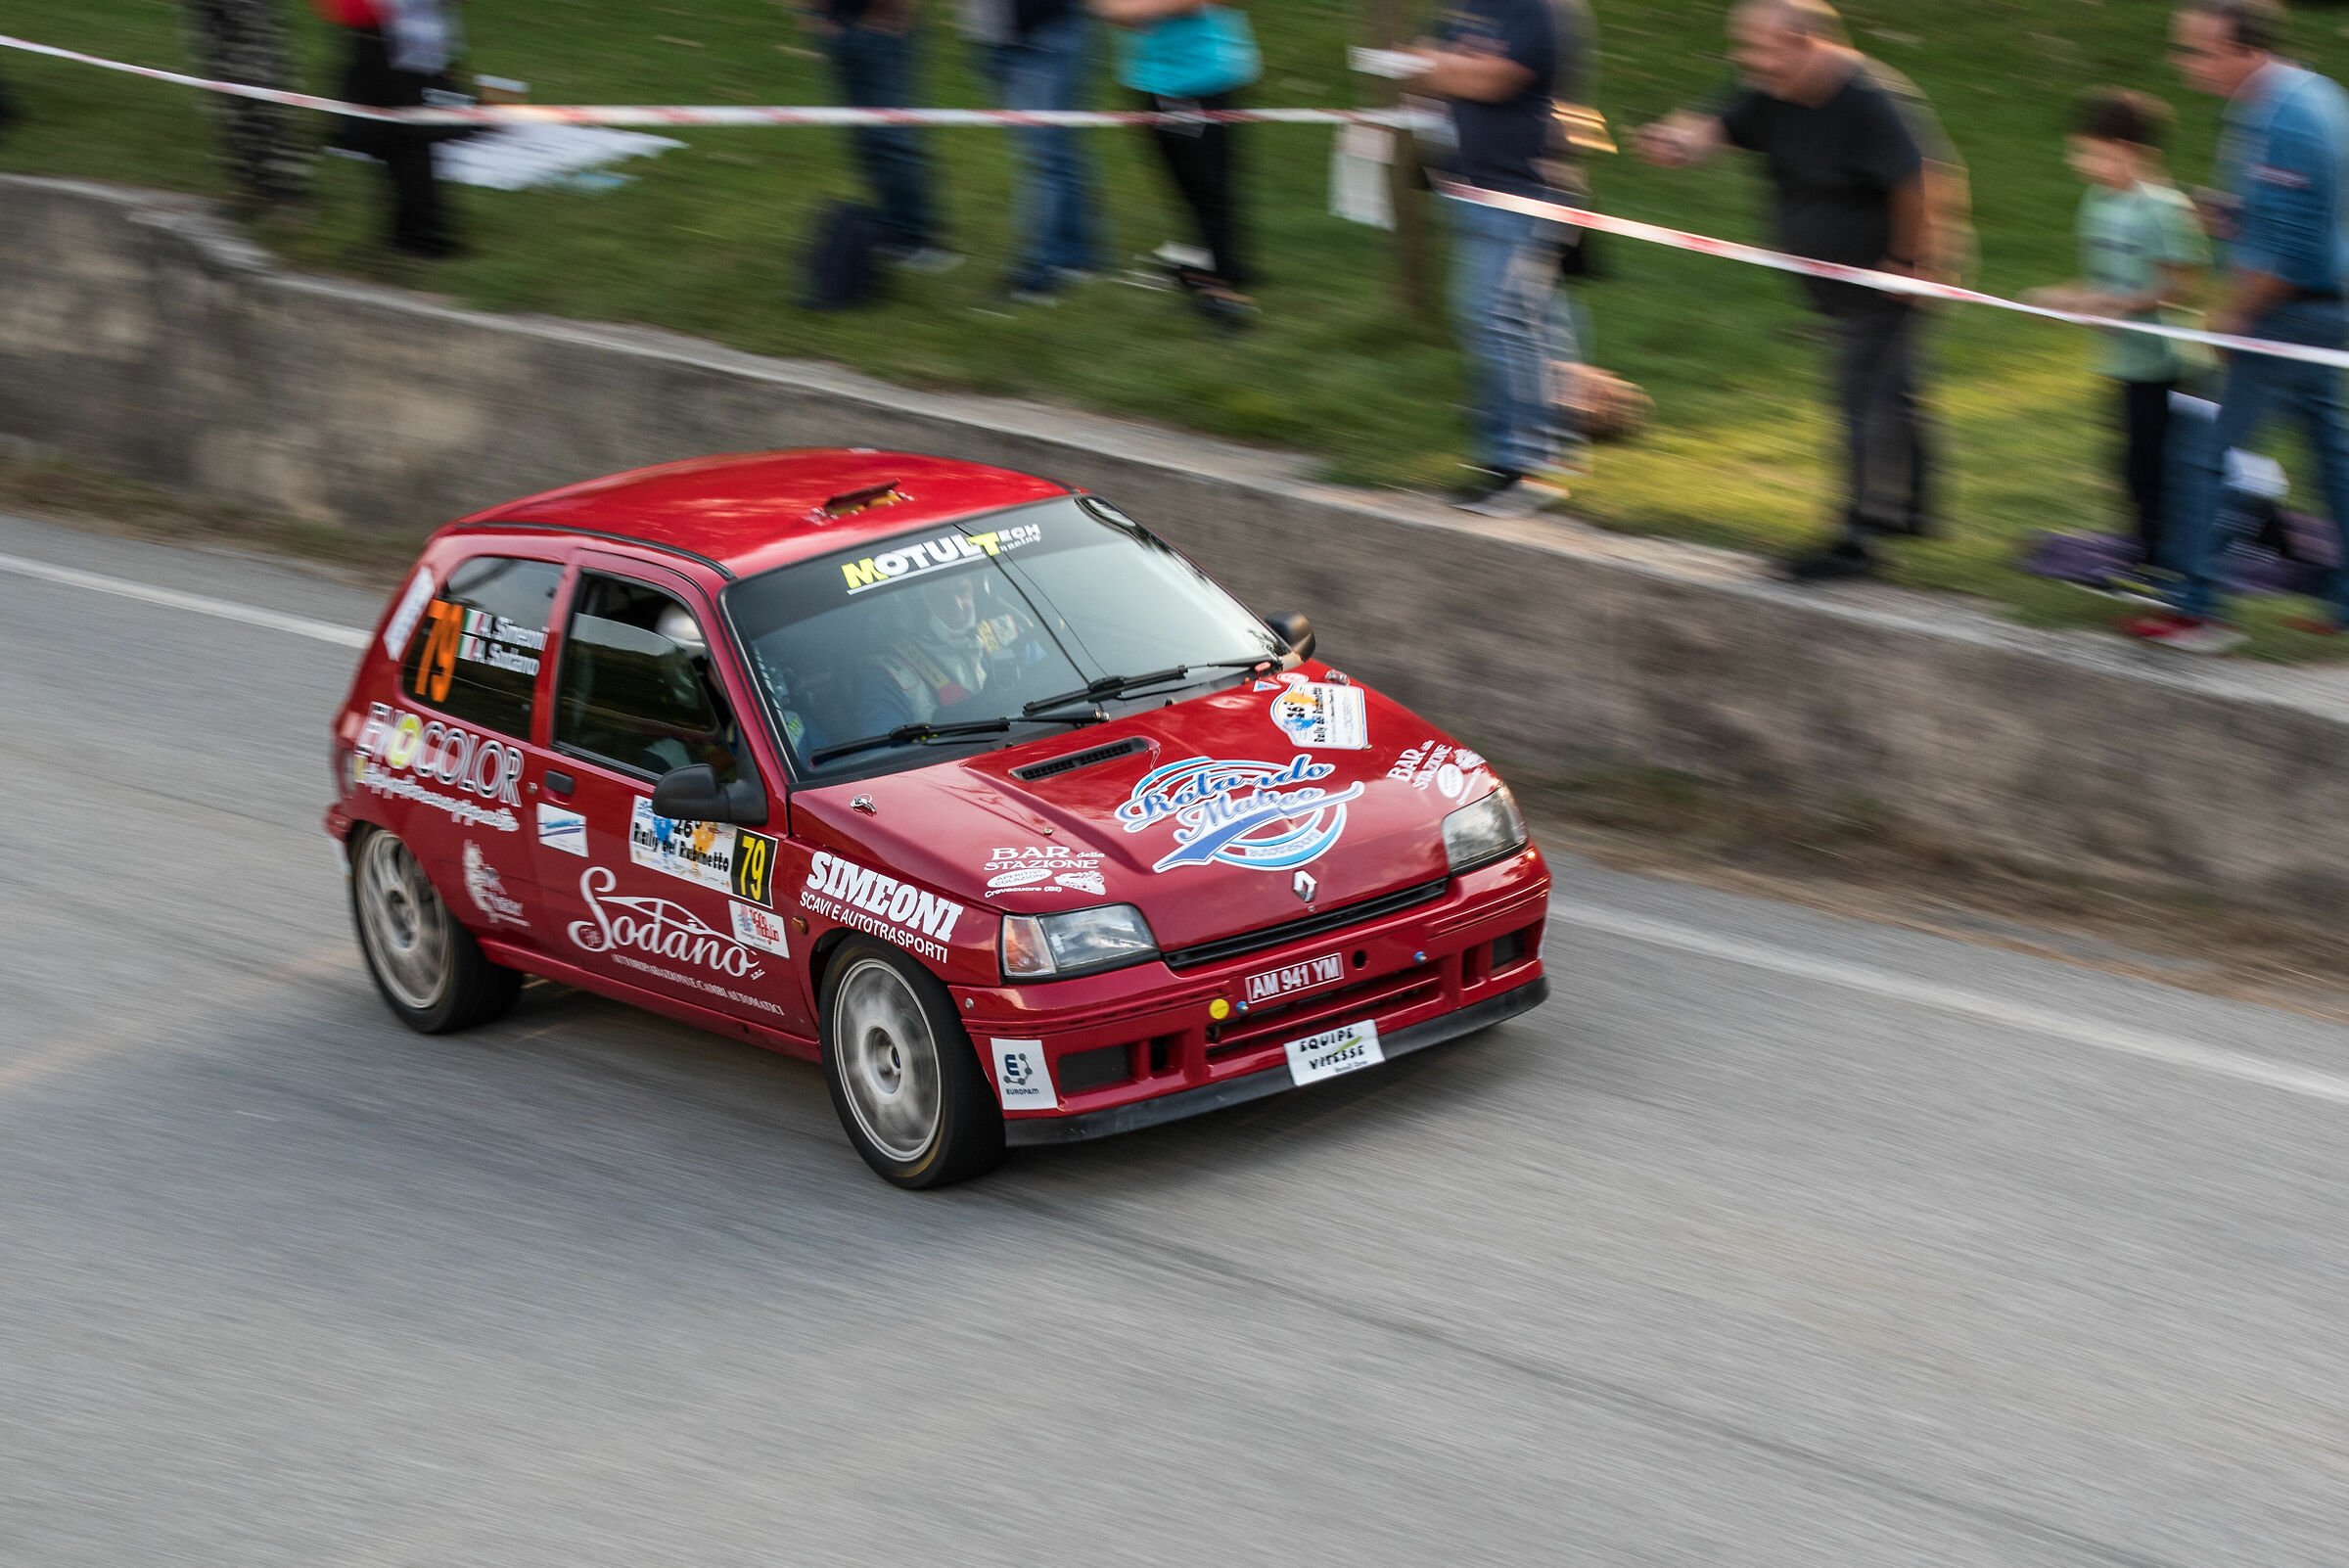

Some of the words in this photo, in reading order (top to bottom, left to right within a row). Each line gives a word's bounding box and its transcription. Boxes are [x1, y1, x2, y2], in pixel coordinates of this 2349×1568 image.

[414, 598, 465, 703] 79
[1386, 748, 1427, 782] BAR
[1117, 755, 1335, 831] Rolando
[633, 822, 660, 852] Rally
[990, 846, 1071, 860] BAR
[740, 835, 765, 900] 79
[984, 859, 1099, 871] STAZIONE
[806, 851, 964, 942] SIMEONI
[567, 866, 760, 977] Sodano
[800, 892, 832, 918] SCAVI
[831, 904, 842, 920] E
[840, 908, 948, 964] AUTOTRASPORTI
[1253, 973, 1279, 998] AM
[1281, 965, 1310, 991] 941
[1312, 957, 1339, 982] YM
[1300, 1028, 1354, 1052] EQUIPE
[1310, 1045, 1364, 1070] VITESSE
